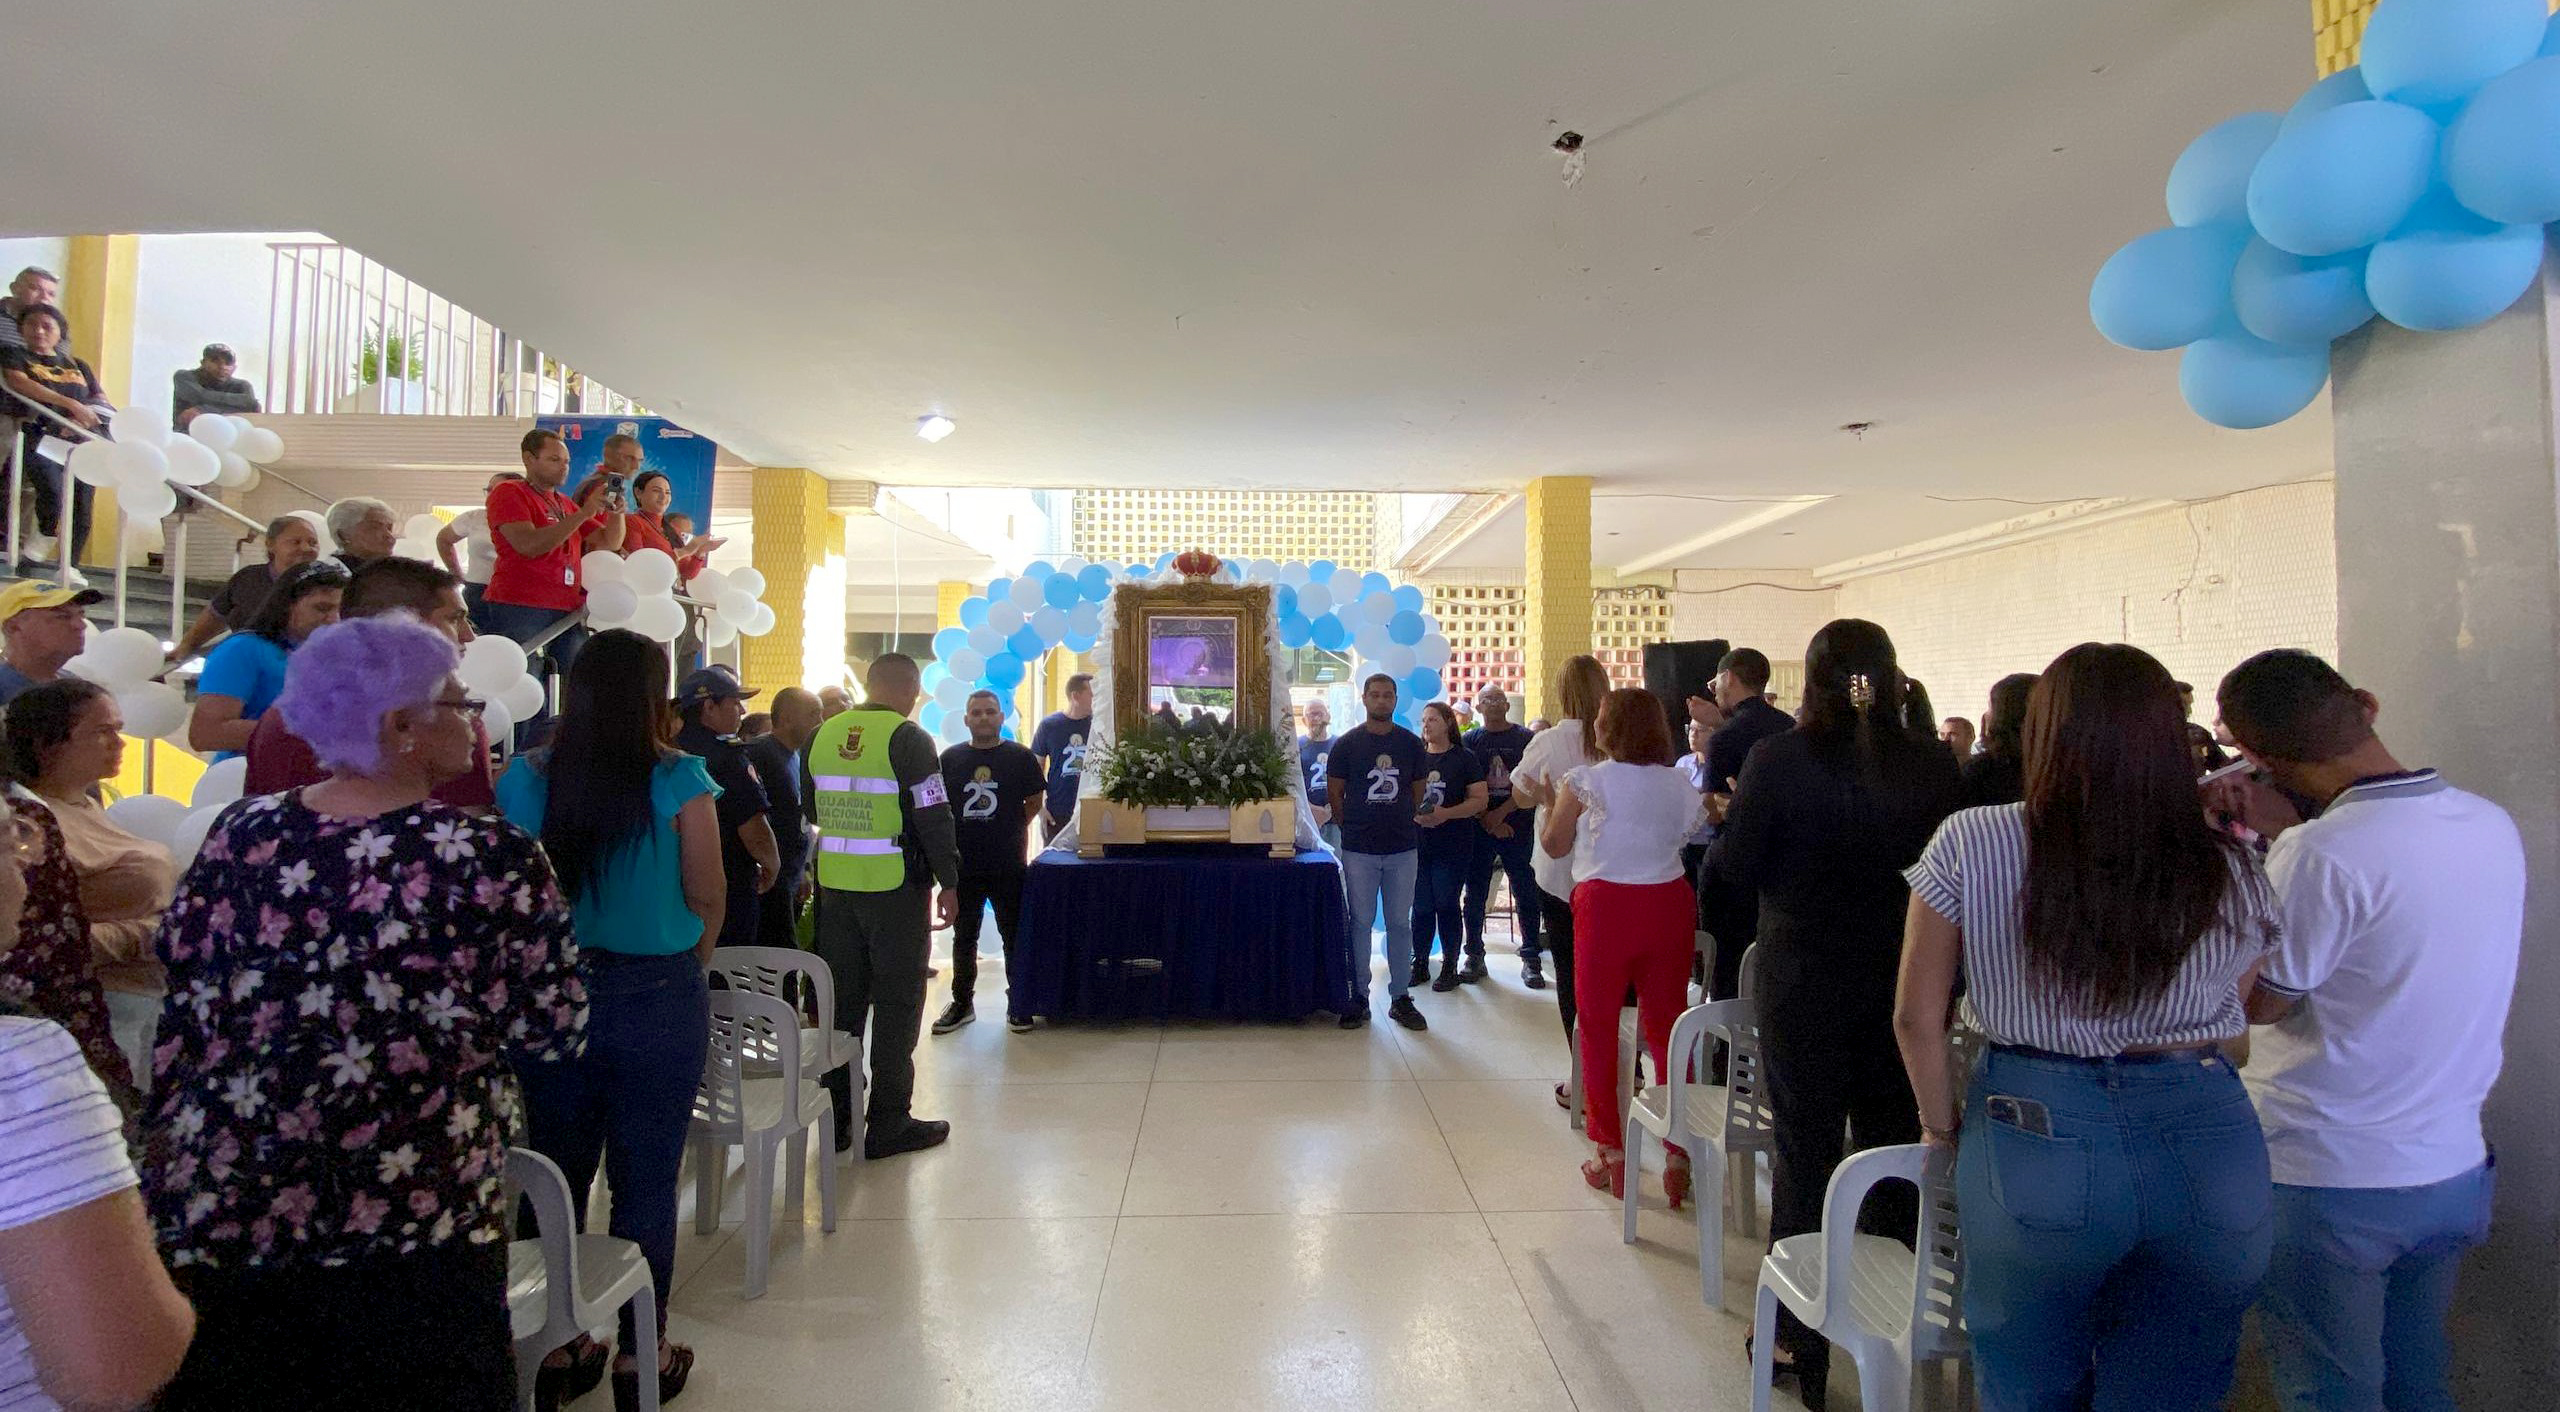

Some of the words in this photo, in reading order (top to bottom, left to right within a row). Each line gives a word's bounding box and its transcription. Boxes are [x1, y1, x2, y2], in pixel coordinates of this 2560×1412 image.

[1367, 769, 1399, 800] 25
[818, 796, 873, 809] GUARDIA
[963, 782, 998, 817] 25
[818, 806, 874, 820] NACIONAL
